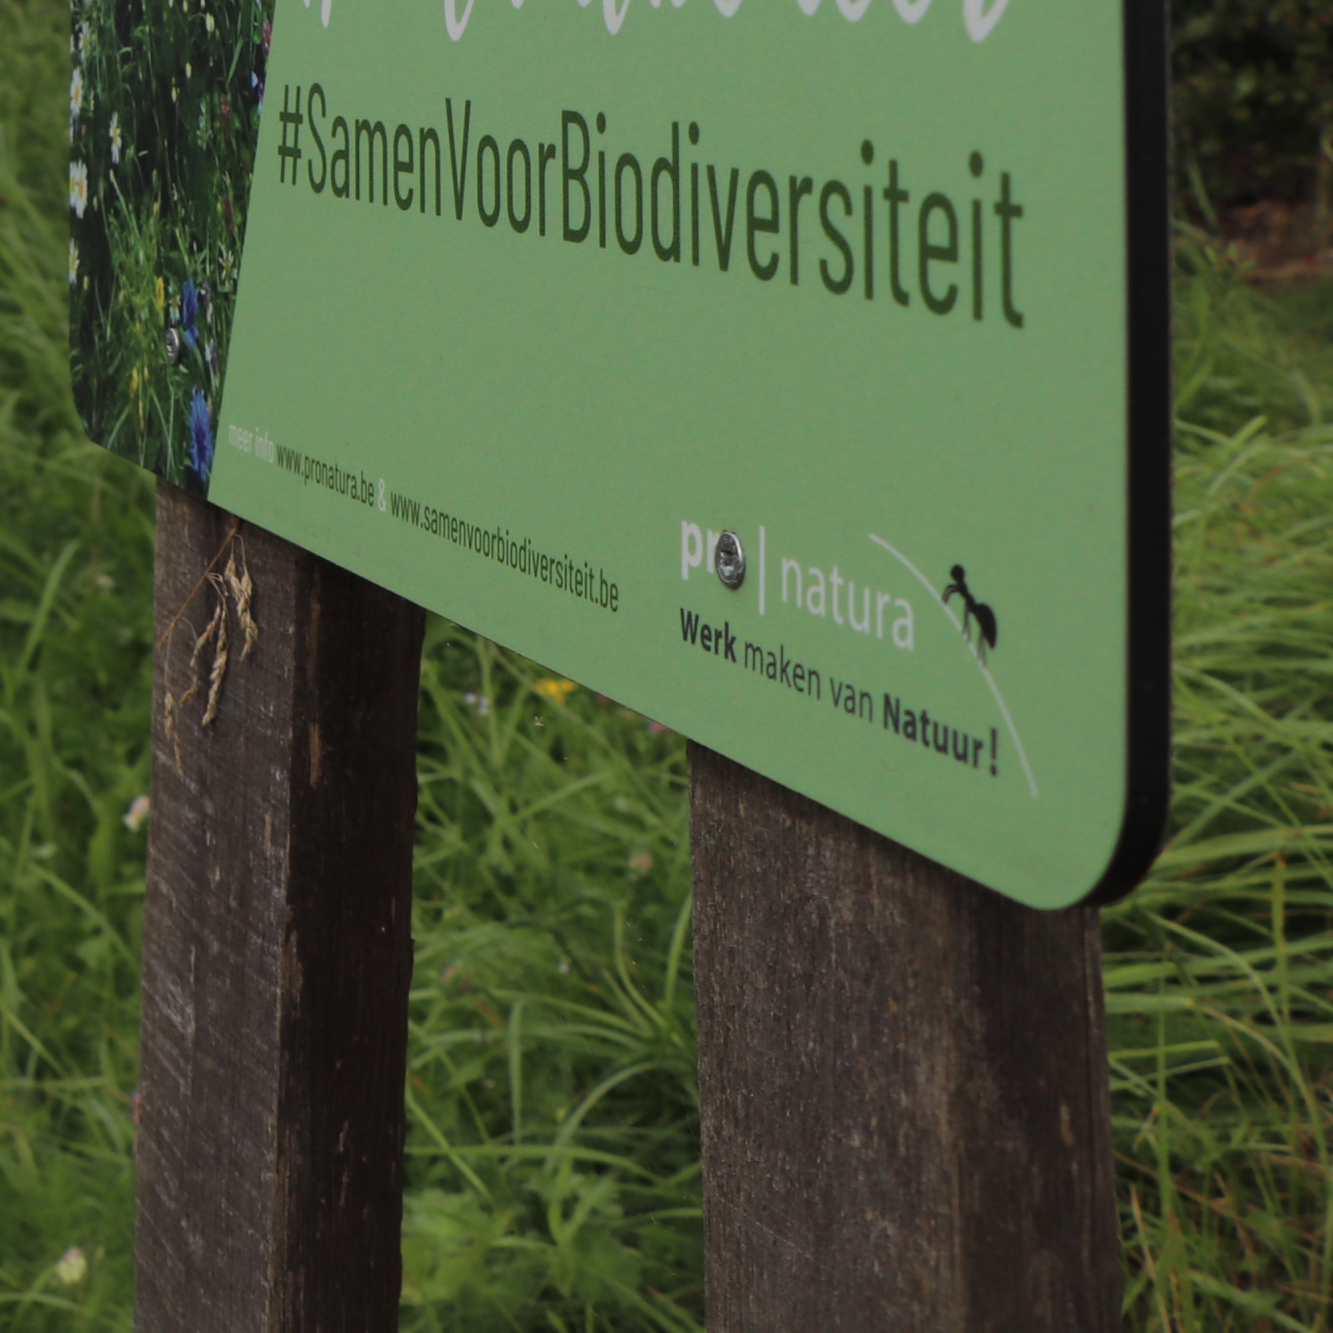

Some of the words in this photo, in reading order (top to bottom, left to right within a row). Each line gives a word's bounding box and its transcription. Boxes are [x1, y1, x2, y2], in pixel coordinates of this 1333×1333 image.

[277, 82, 1026, 329] #SamenVoorBiodiversiteit
[228, 423, 253, 454] meer
[254, 426, 275, 464] info
[276, 443, 375, 507] www.pronatura.be
[377, 478, 387, 513] &
[390, 491, 619, 613] www.samenvoorbiodiversiteit.be
[781, 557, 915, 651] natura
[680, 608, 737, 664] Werk
[744, 640, 822, 701] maken
[829, 677, 874, 723] van
[883, 692, 999, 778] Natuur!
